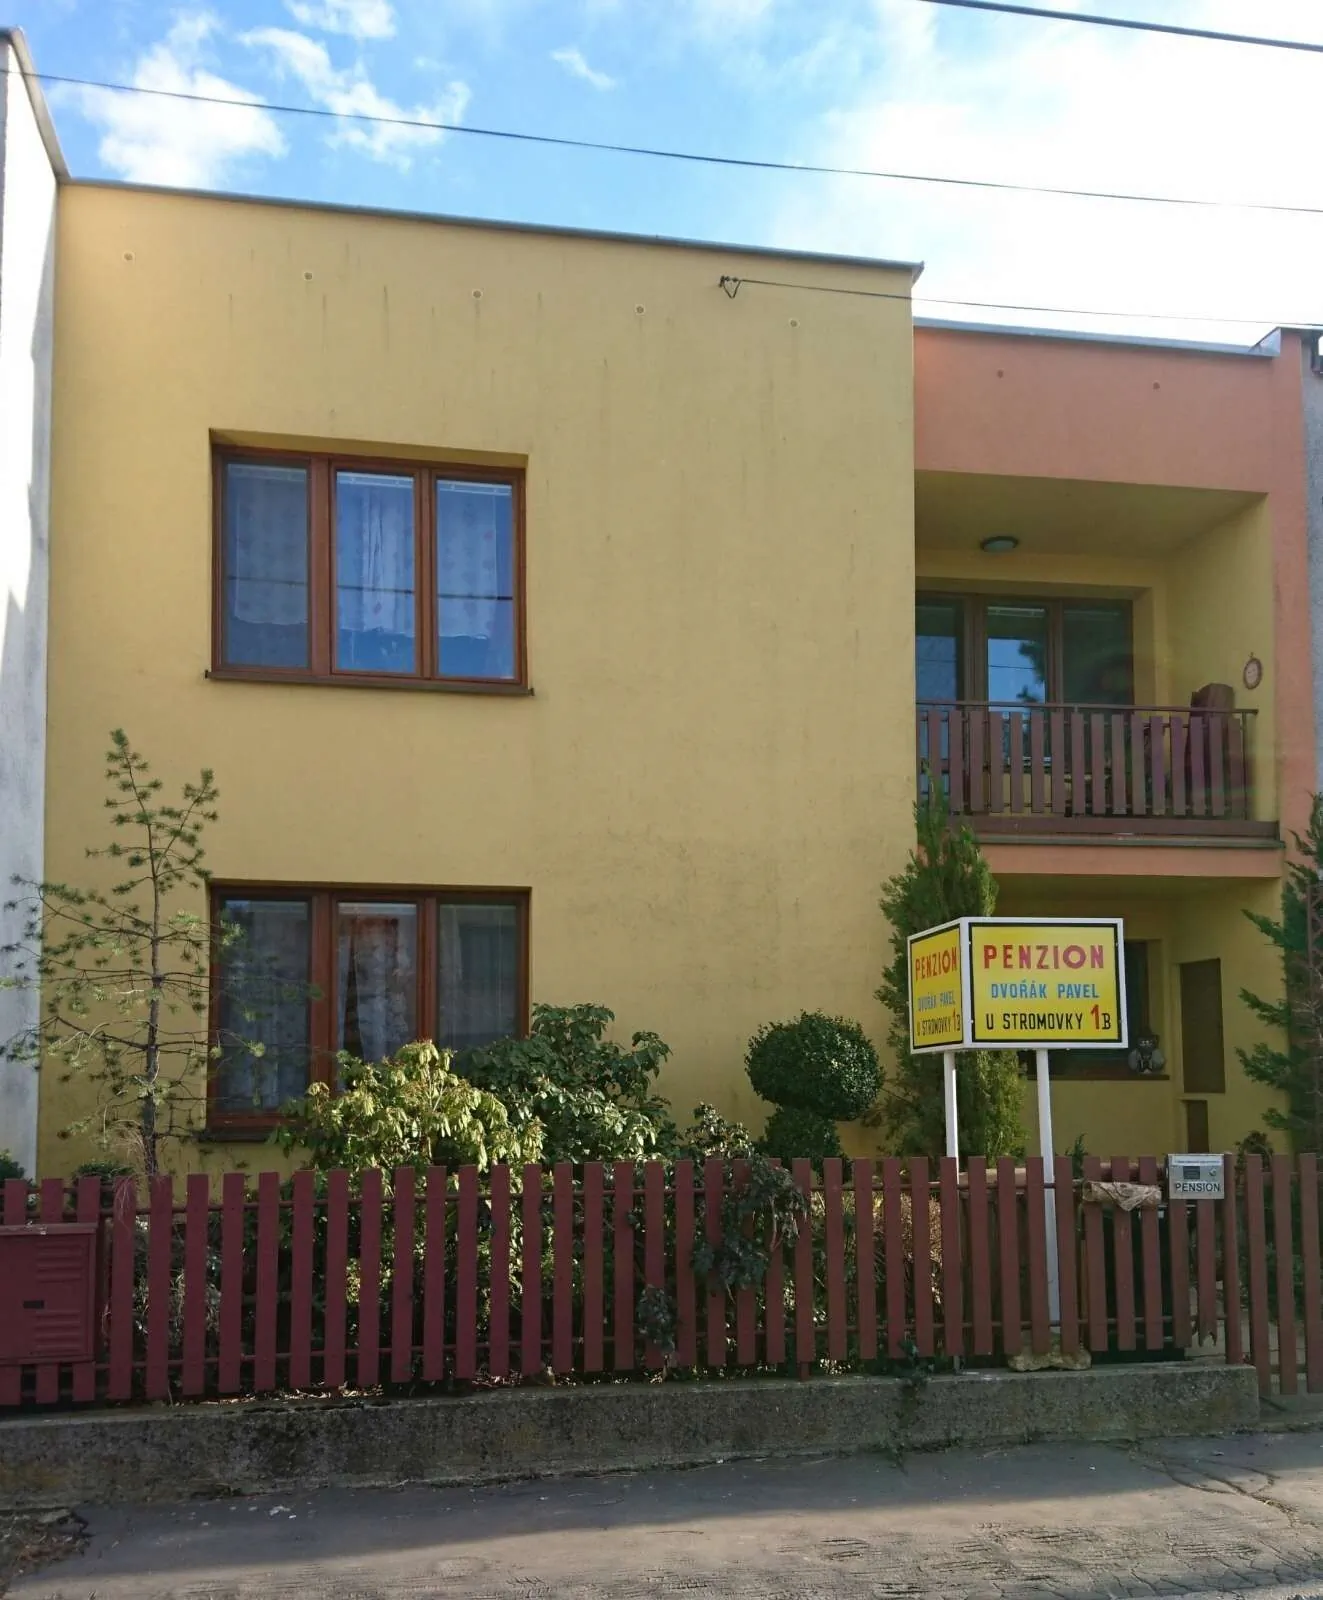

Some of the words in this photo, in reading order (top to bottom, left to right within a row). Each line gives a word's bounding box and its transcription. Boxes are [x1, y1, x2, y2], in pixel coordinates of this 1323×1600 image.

[915, 947, 957, 981] PENZION
[984, 945, 1104, 969] PENZION
[991, 980, 1047, 998] DVOŘÁK
[1058, 984, 1099, 998] PAVEL
[986, 1013, 994, 1030] U
[1003, 1013, 1084, 1030] STROMOVKY
[1175, 1182, 1220, 1192] PENSION
